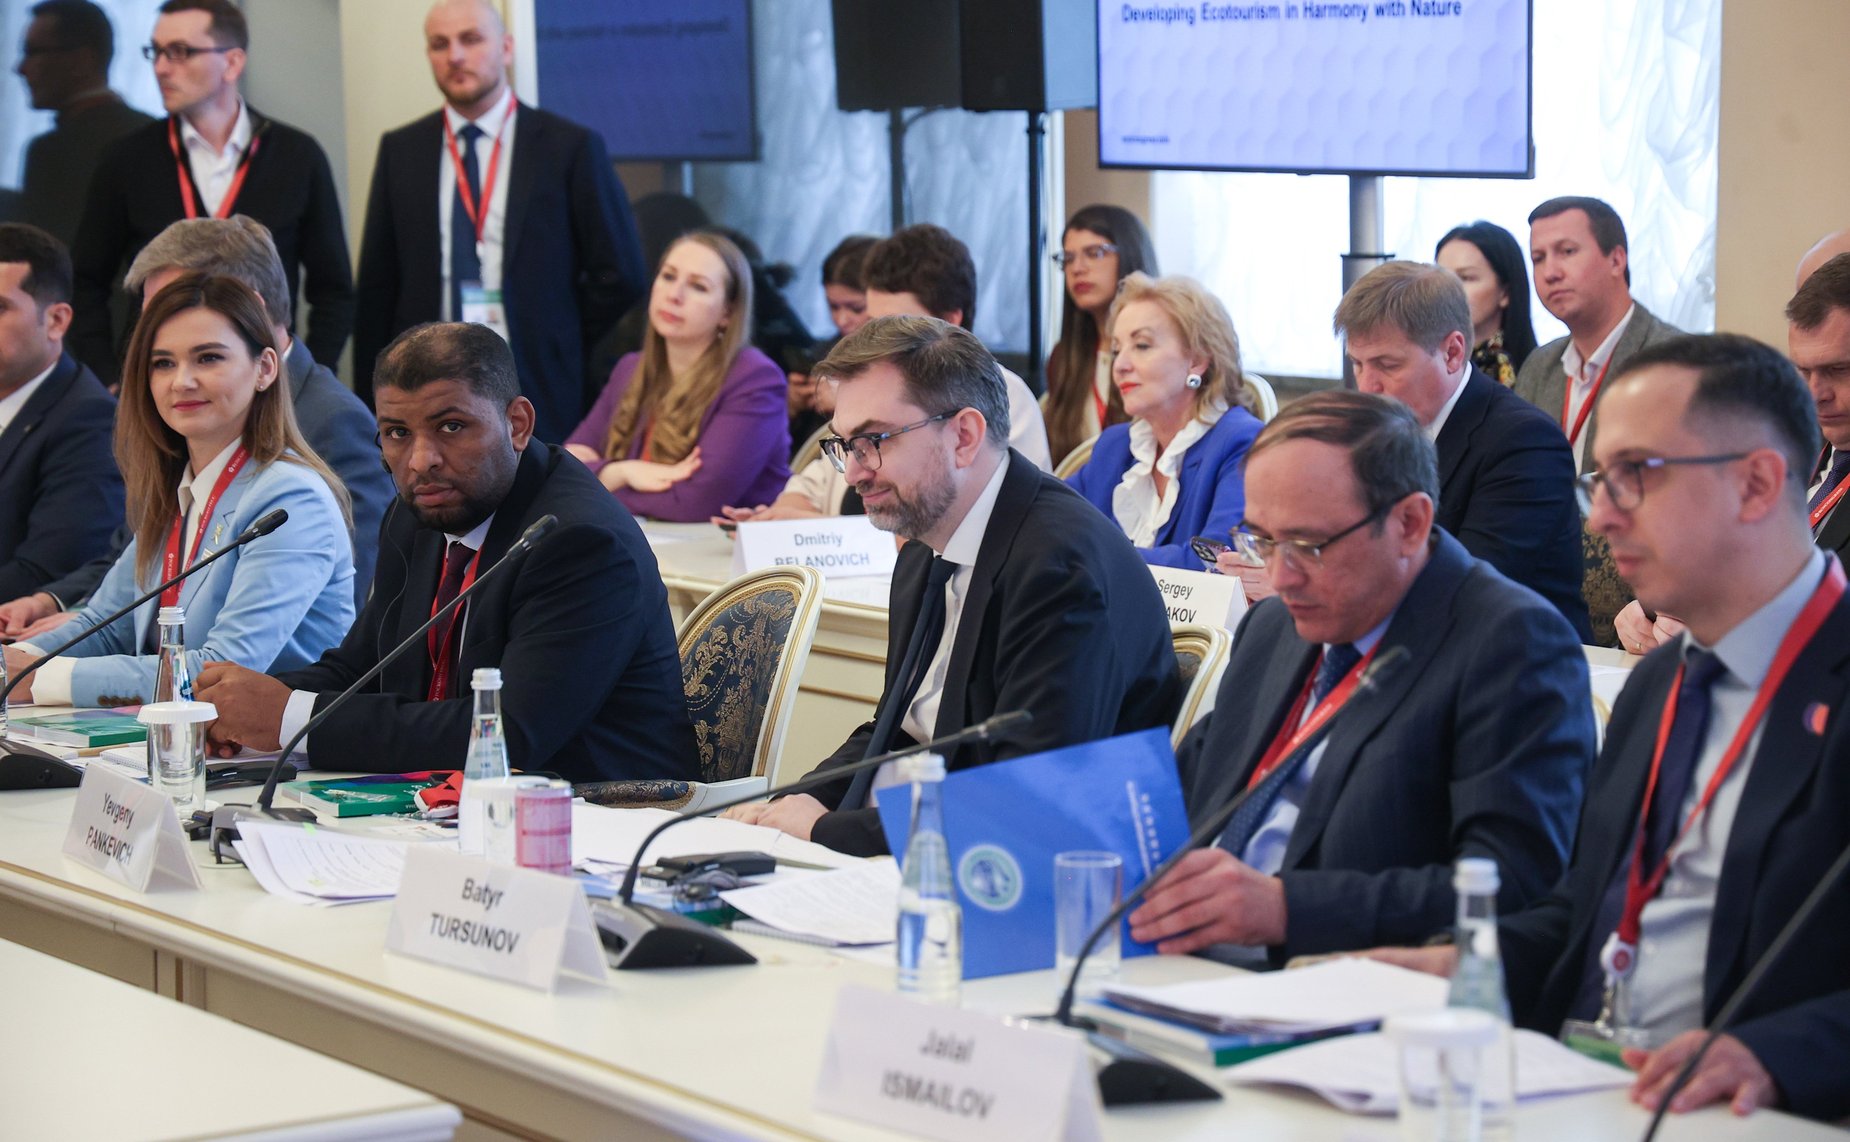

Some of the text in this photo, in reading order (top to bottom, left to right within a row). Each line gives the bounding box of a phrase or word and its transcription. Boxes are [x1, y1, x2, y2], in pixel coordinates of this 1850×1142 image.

[1122, 0, 1462, 25] Developing Ecotourism in Harmony with Nature
[794, 532, 843, 547] Dmitriy
[1158, 579, 1193, 600] Sergey
[102, 793, 135, 829] Yevgeny
[85, 826, 134, 864] PANKEVICH
[461, 877, 504, 911] Batyr
[430, 912, 520, 954] TURSUNOV
[920, 1029, 975, 1063] Jalal
[880, 1069, 994, 1118] ISMAILOV
